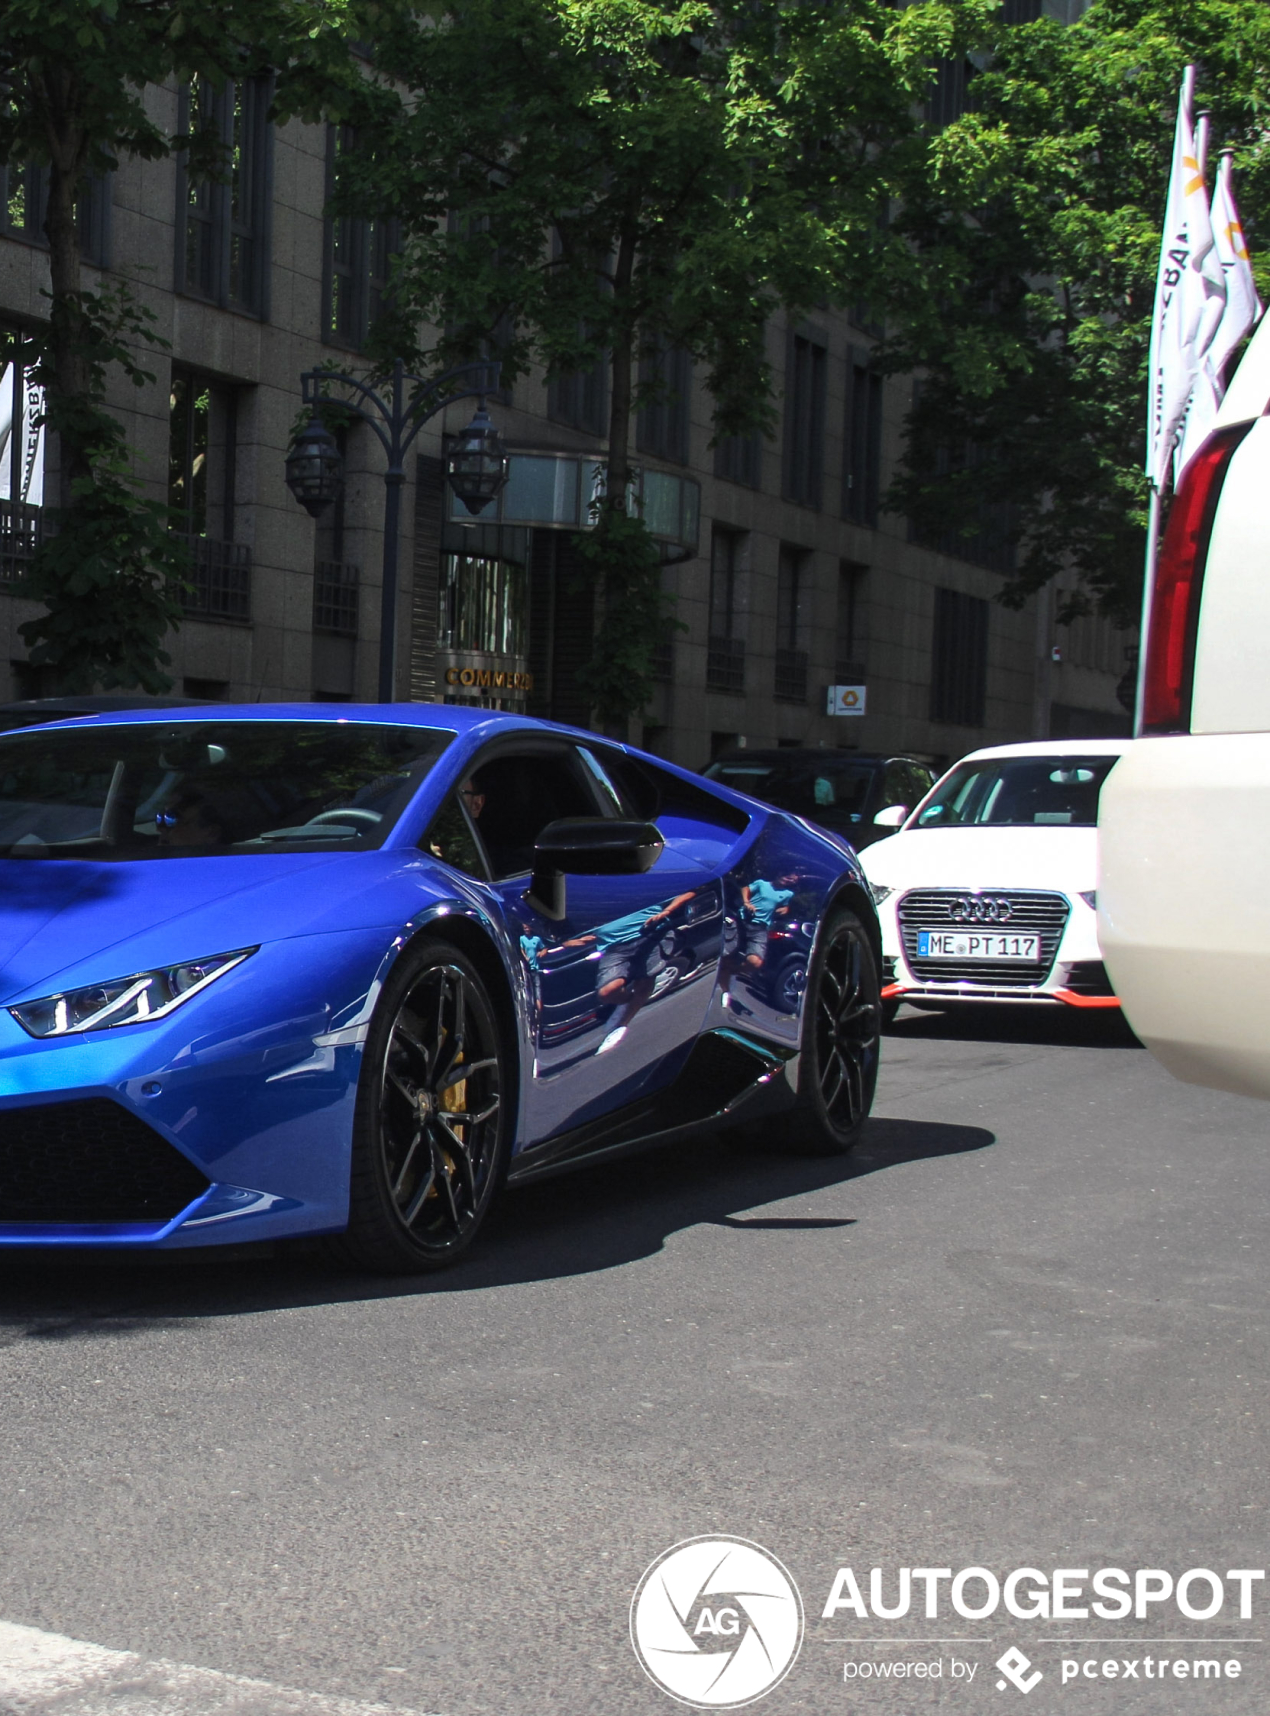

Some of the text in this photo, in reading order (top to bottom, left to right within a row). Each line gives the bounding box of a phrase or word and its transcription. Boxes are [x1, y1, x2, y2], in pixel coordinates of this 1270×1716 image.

[930, 936, 1035, 956] ME PT 117
